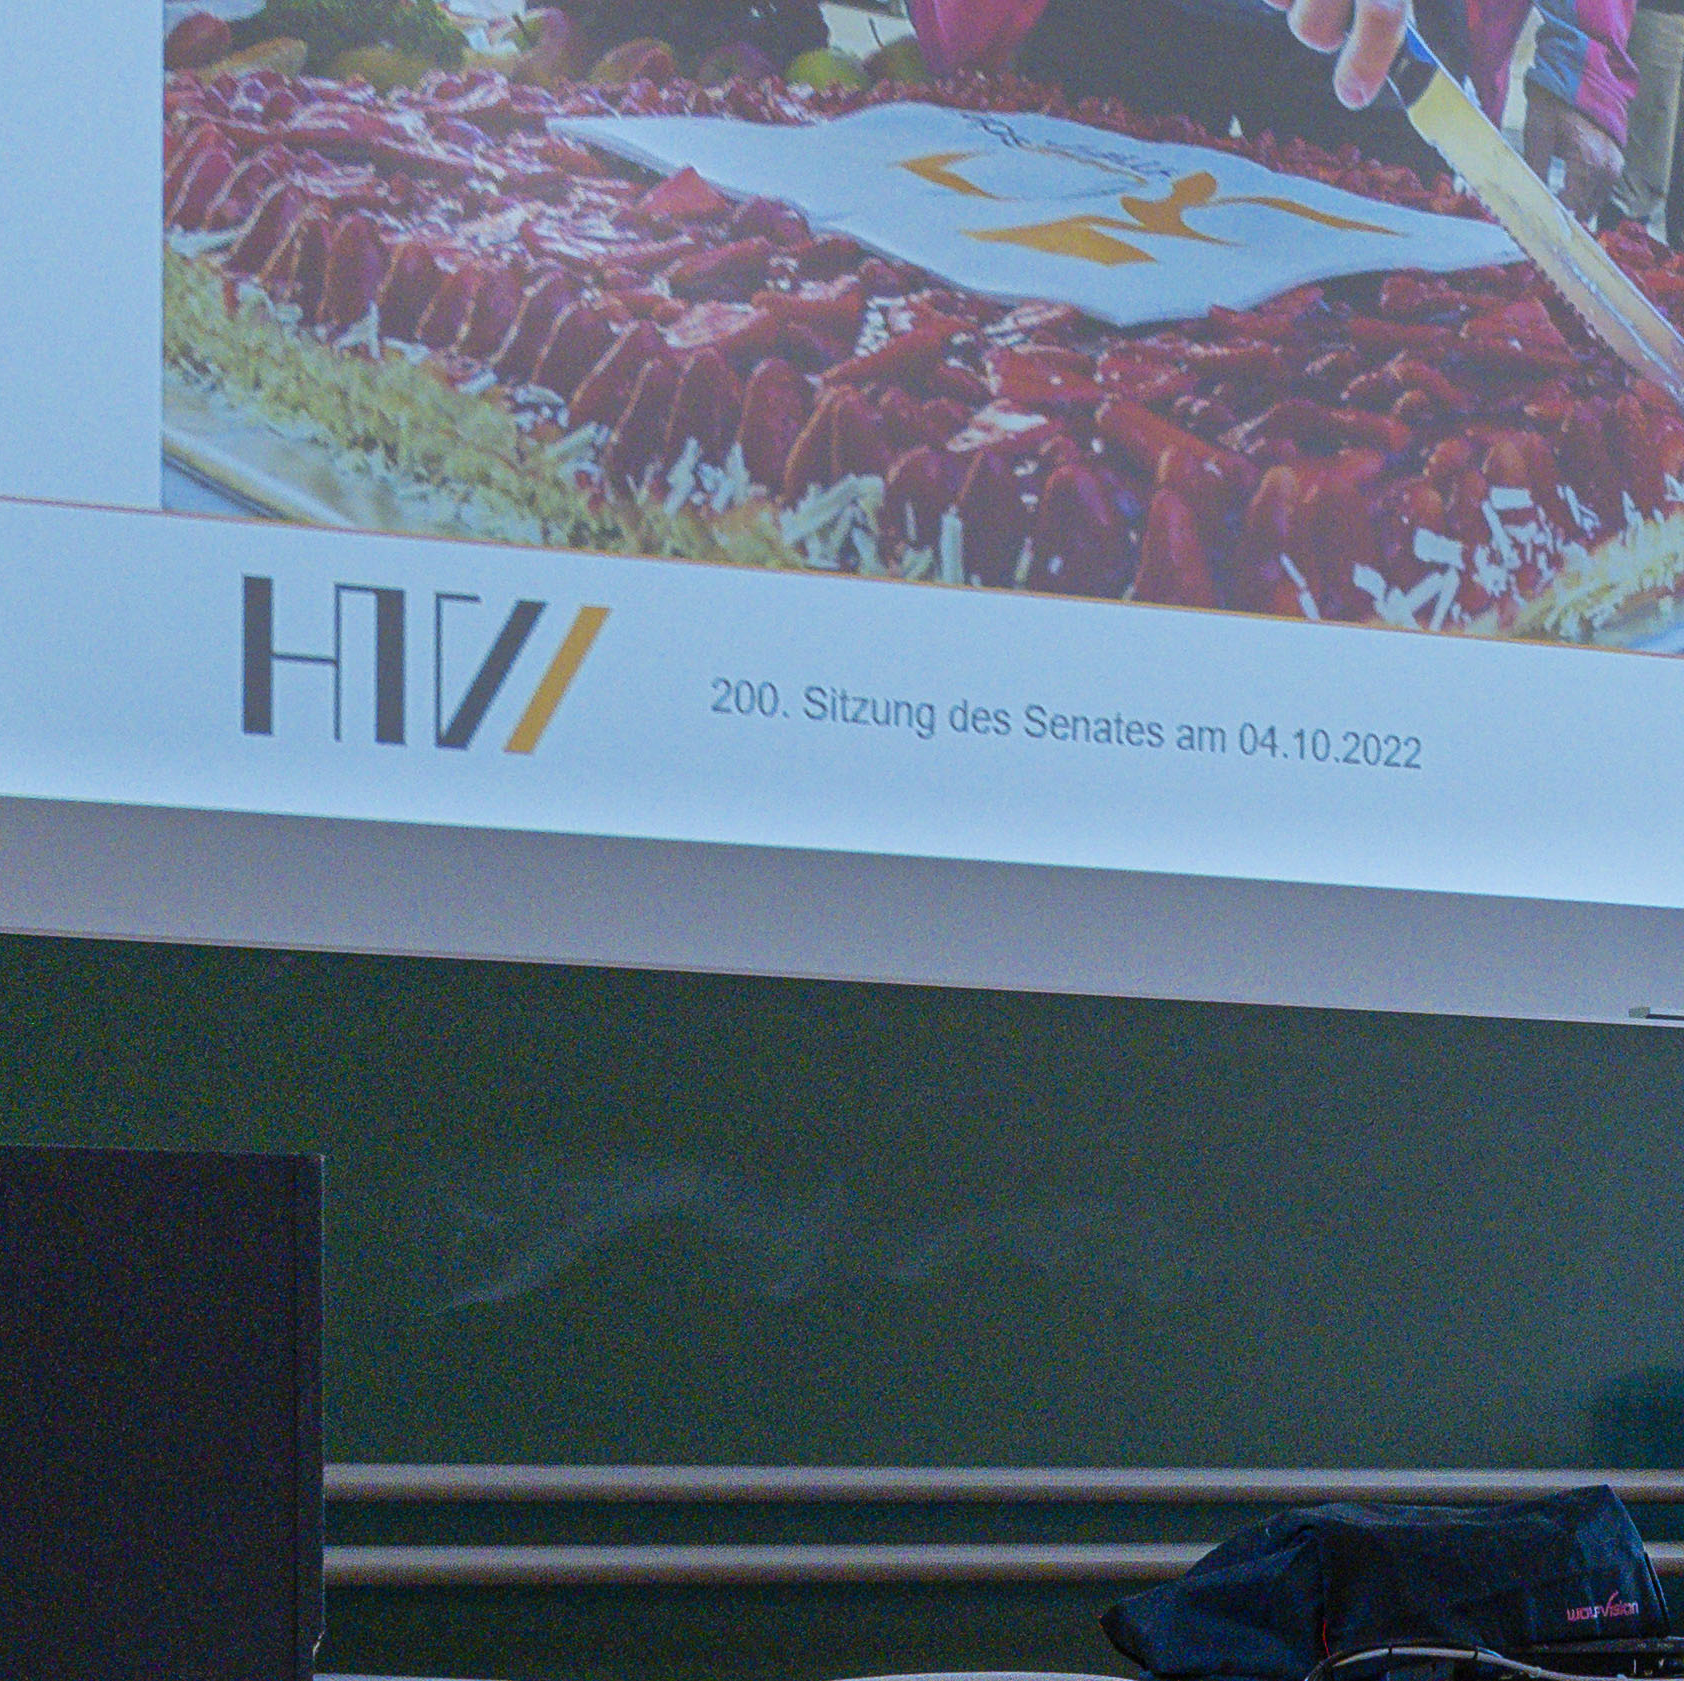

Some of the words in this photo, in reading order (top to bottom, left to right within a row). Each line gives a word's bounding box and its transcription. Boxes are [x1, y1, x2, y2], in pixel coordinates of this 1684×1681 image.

[710, 676, 789, 718] 200.
[802, 684, 936, 740] Sitzung
[948, 698, 1012, 736] des
[1023, 704, 1166, 749] Senates
[1176, 723, 1226, 753] am
[1238, 721, 1422, 770] 04.10.2022
